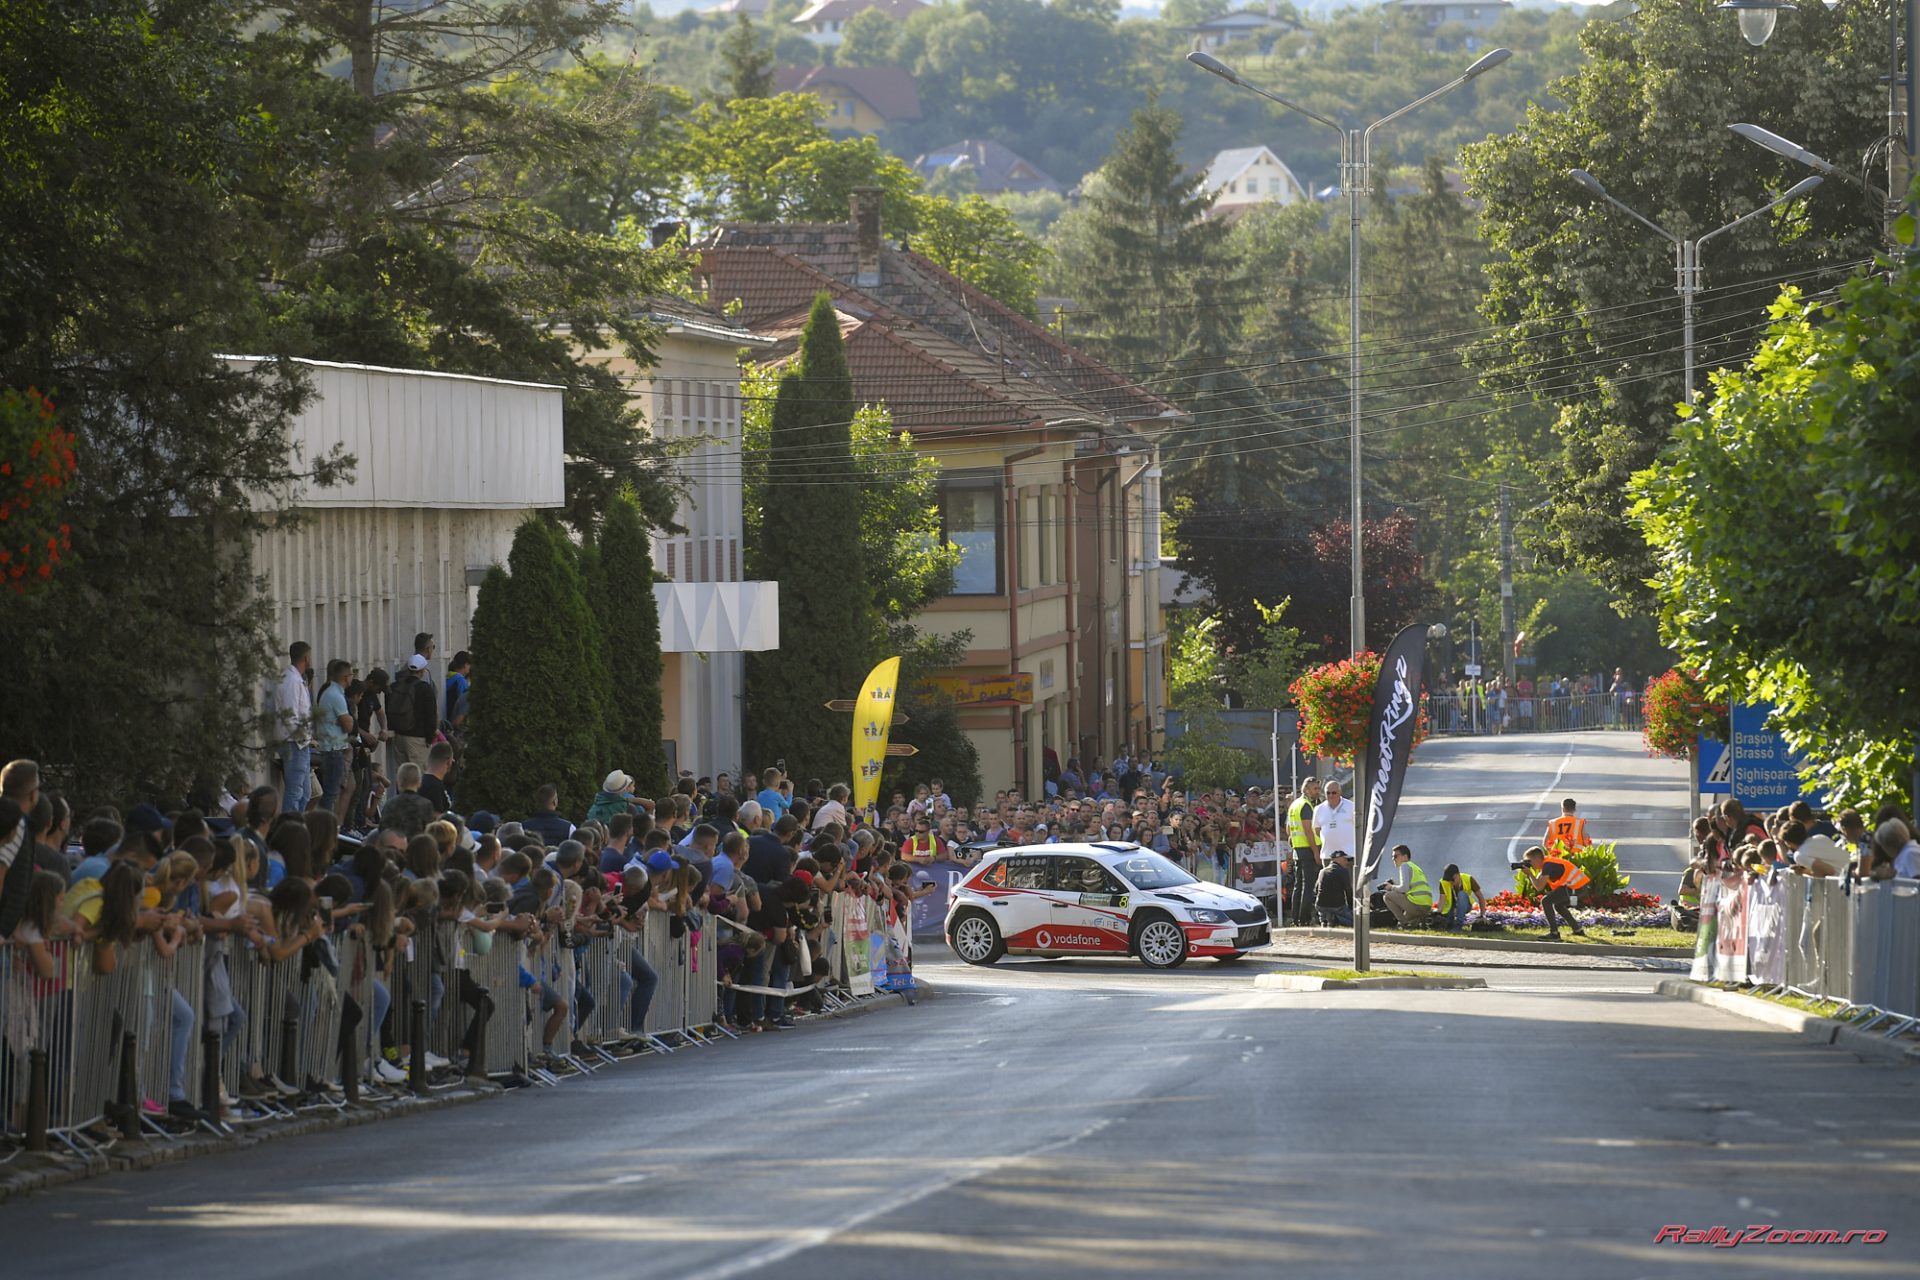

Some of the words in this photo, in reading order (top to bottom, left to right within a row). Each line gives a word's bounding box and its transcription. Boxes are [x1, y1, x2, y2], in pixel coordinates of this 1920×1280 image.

[1735, 732, 1774, 746] Braşov
[1735, 746, 1774, 759] Brassó
[1736, 768, 1794, 782] Sighişoara
[1736, 784, 1787, 798] Segesvár
[1558, 823, 1572, 835] 17
[1119, 896, 1128, 908] 8
[1053, 933, 1101, 945] vodafone
